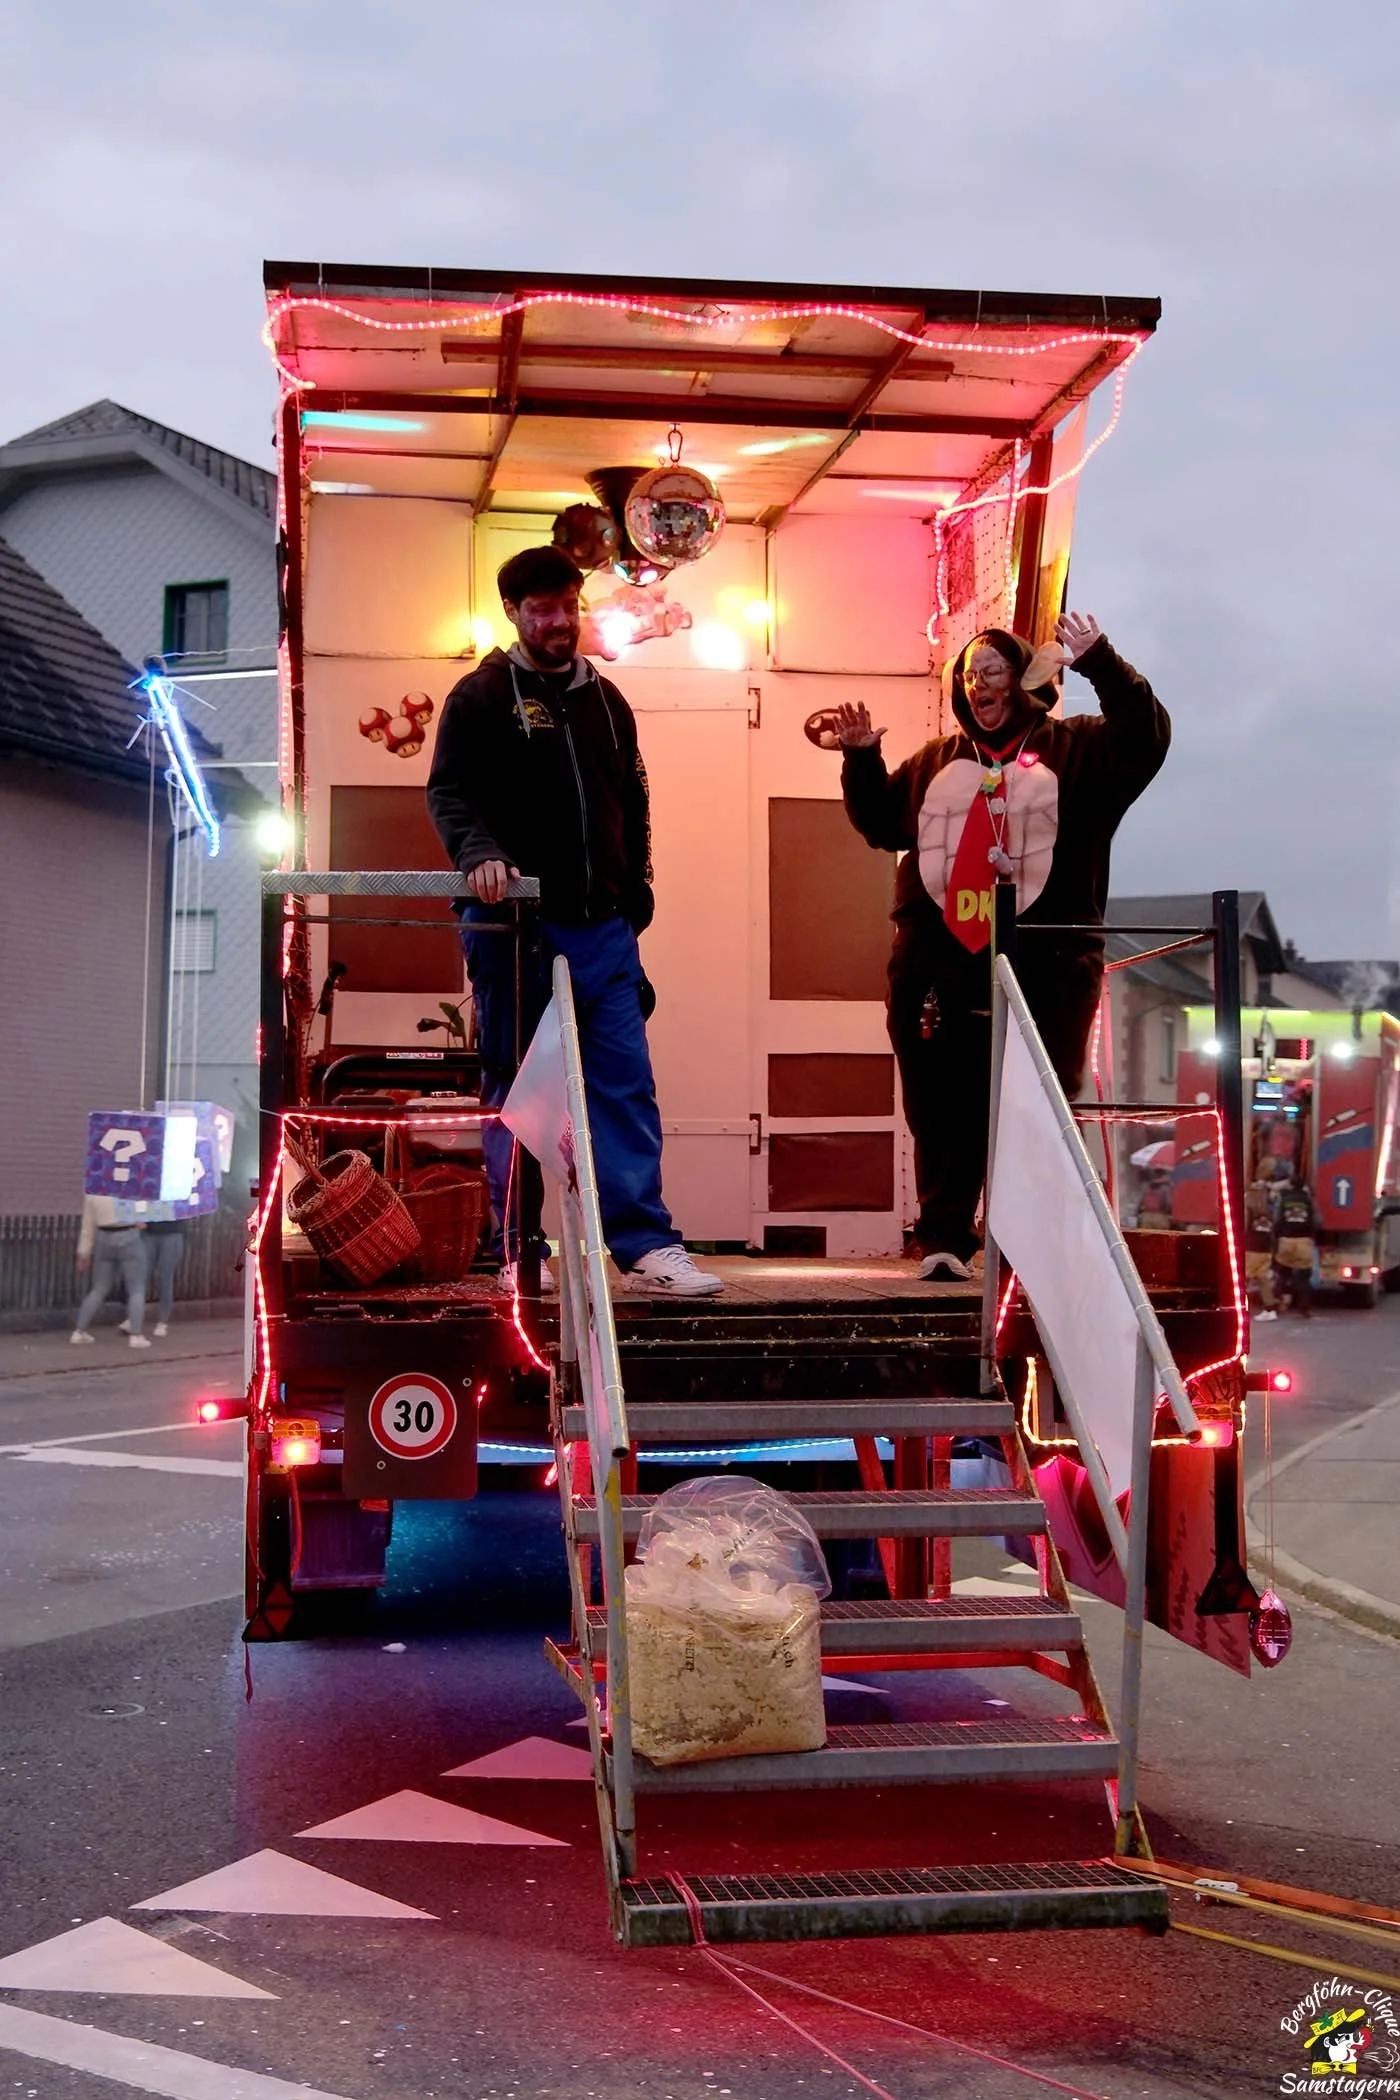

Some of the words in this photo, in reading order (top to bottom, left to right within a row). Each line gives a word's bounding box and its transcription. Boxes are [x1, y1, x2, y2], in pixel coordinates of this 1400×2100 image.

[957, 889, 993, 922] DK
[100, 1128, 147, 1182] ?
[393, 1400, 434, 1433] 30
